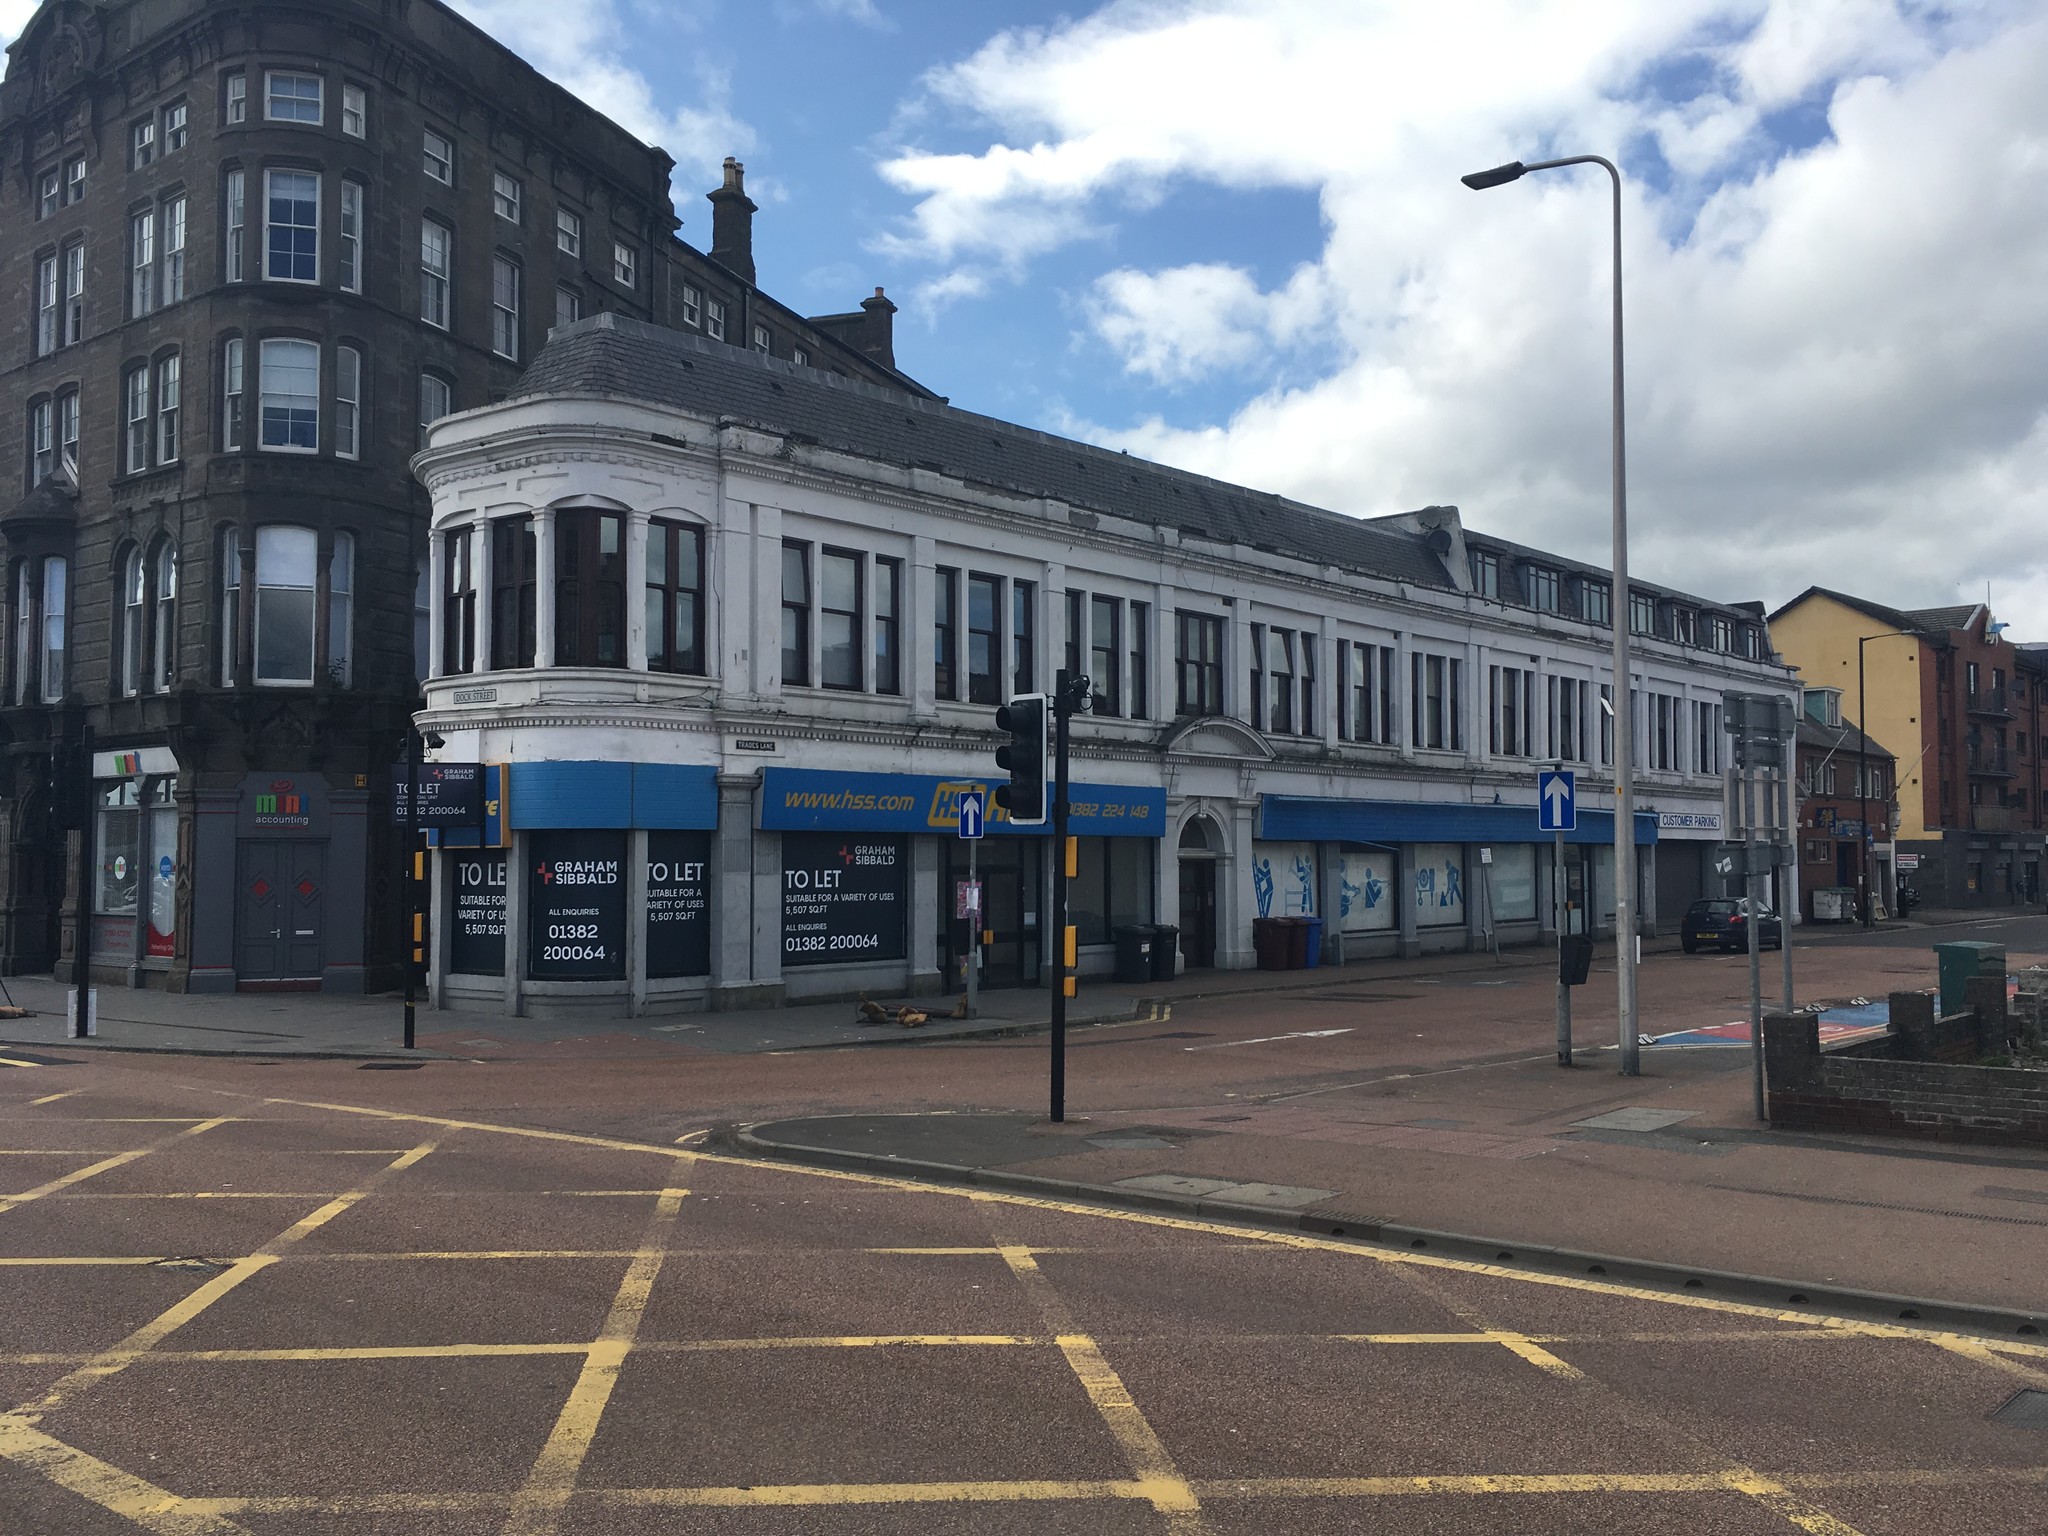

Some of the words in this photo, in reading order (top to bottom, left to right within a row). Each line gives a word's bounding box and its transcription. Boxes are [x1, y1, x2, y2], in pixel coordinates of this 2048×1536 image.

[456, 693, 471, 702] DOCK
[473, 691, 494, 701] STREET
[738, 741, 759, 749] TRADES
[419, 783, 441, 794] LET
[785, 788, 915, 811] www.hss.com
[429, 806, 467, 815] 200064
[1102, 803, 1126, 818] 224
[1129, 804, 1149, 819] 148
[255, 815, 309, 826] accounting
[1662, 814, 1693, 827] CUSTOMER
[1694, 815, 1717, 828] PARKING
[855, 845, 896, 855] GRAHAM
[855, 855, 896, 865] SIBBALD
[555, 861, 618, 873] GRAHAM
[675, 862, 705, 882] LET
[459, 862, 482, 886] TO
[555, 873, 618, 885] SIBBALD
[785, 869, 809, 889] TO
[814, 869, 842, 888] LET
[679, 888, 695, 897] FOR
[696, 888, 703, 897] A
[786, 893, 817, 903] SUITABLE
[817, 893, 833, 902] FOR
[833, 893, 840, 902] A
[841, 893, 868, 902] VARIETY
[868, 892, 878, 901] OF
[879, 892, 895, 901] USES
[460, 895, 491, 906] SUITABLE
[492, 895, 506, 906] FOR
[647, 900, 673, 909] ARIETY
[674, 900, 686, 909] OF
[686, 899, 705, 908] USES
[457, 909, 486, 920] VARIETY
[487, 910, 498, 921] OF
[548, 908, 561, 916] ALL
[562, 908, 600, 916] ENQUIRIES
[785, 905, 807, 916] 5,507
[650, 912, 674, 923] 5,507
[465, 924, 487, 936] 5,507
[548, 924, 599, 939] 01382
[785, 924, 797, 932] ALL
[797, 922, 828, 931] ENQUIRIES
[786, 936, 826, 952] 01382
[830, 934, 879, 950] 200064
[543, 945, 606, 961] 200064
